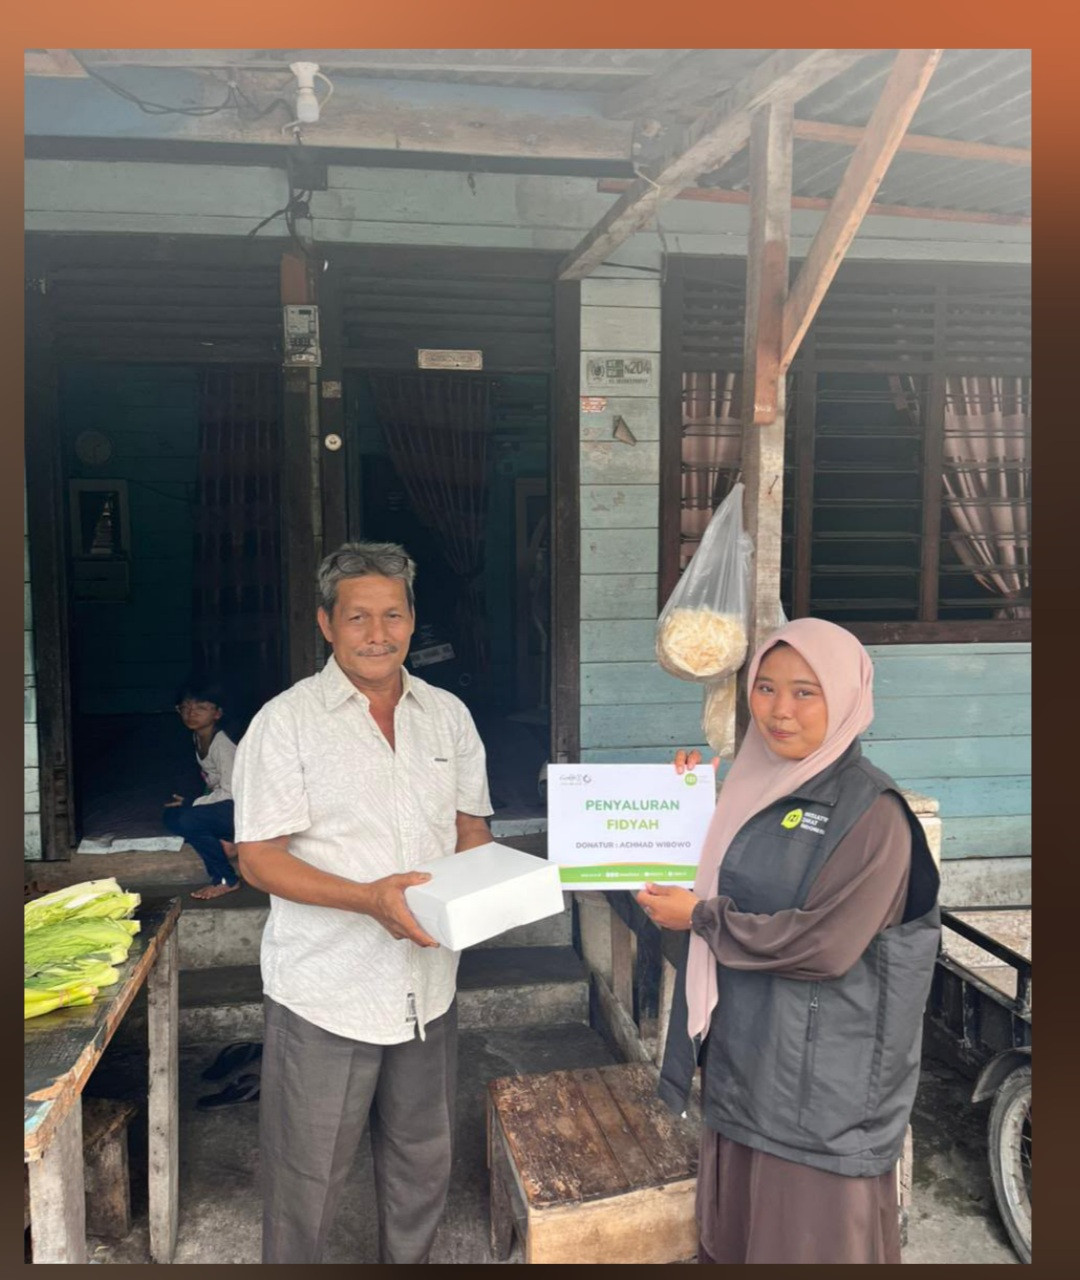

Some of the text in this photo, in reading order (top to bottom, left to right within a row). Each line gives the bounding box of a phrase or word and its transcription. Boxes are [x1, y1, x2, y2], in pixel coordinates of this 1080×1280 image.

[585, 799, 680, 811] PENYALURAN
[606, 819, 659, 830] FIDYAH
[575, 841, 614, 849] DONATUR
[619, 841, 654, 849] ACHMAD
[656, 841, 692, 849] WIBOWO
